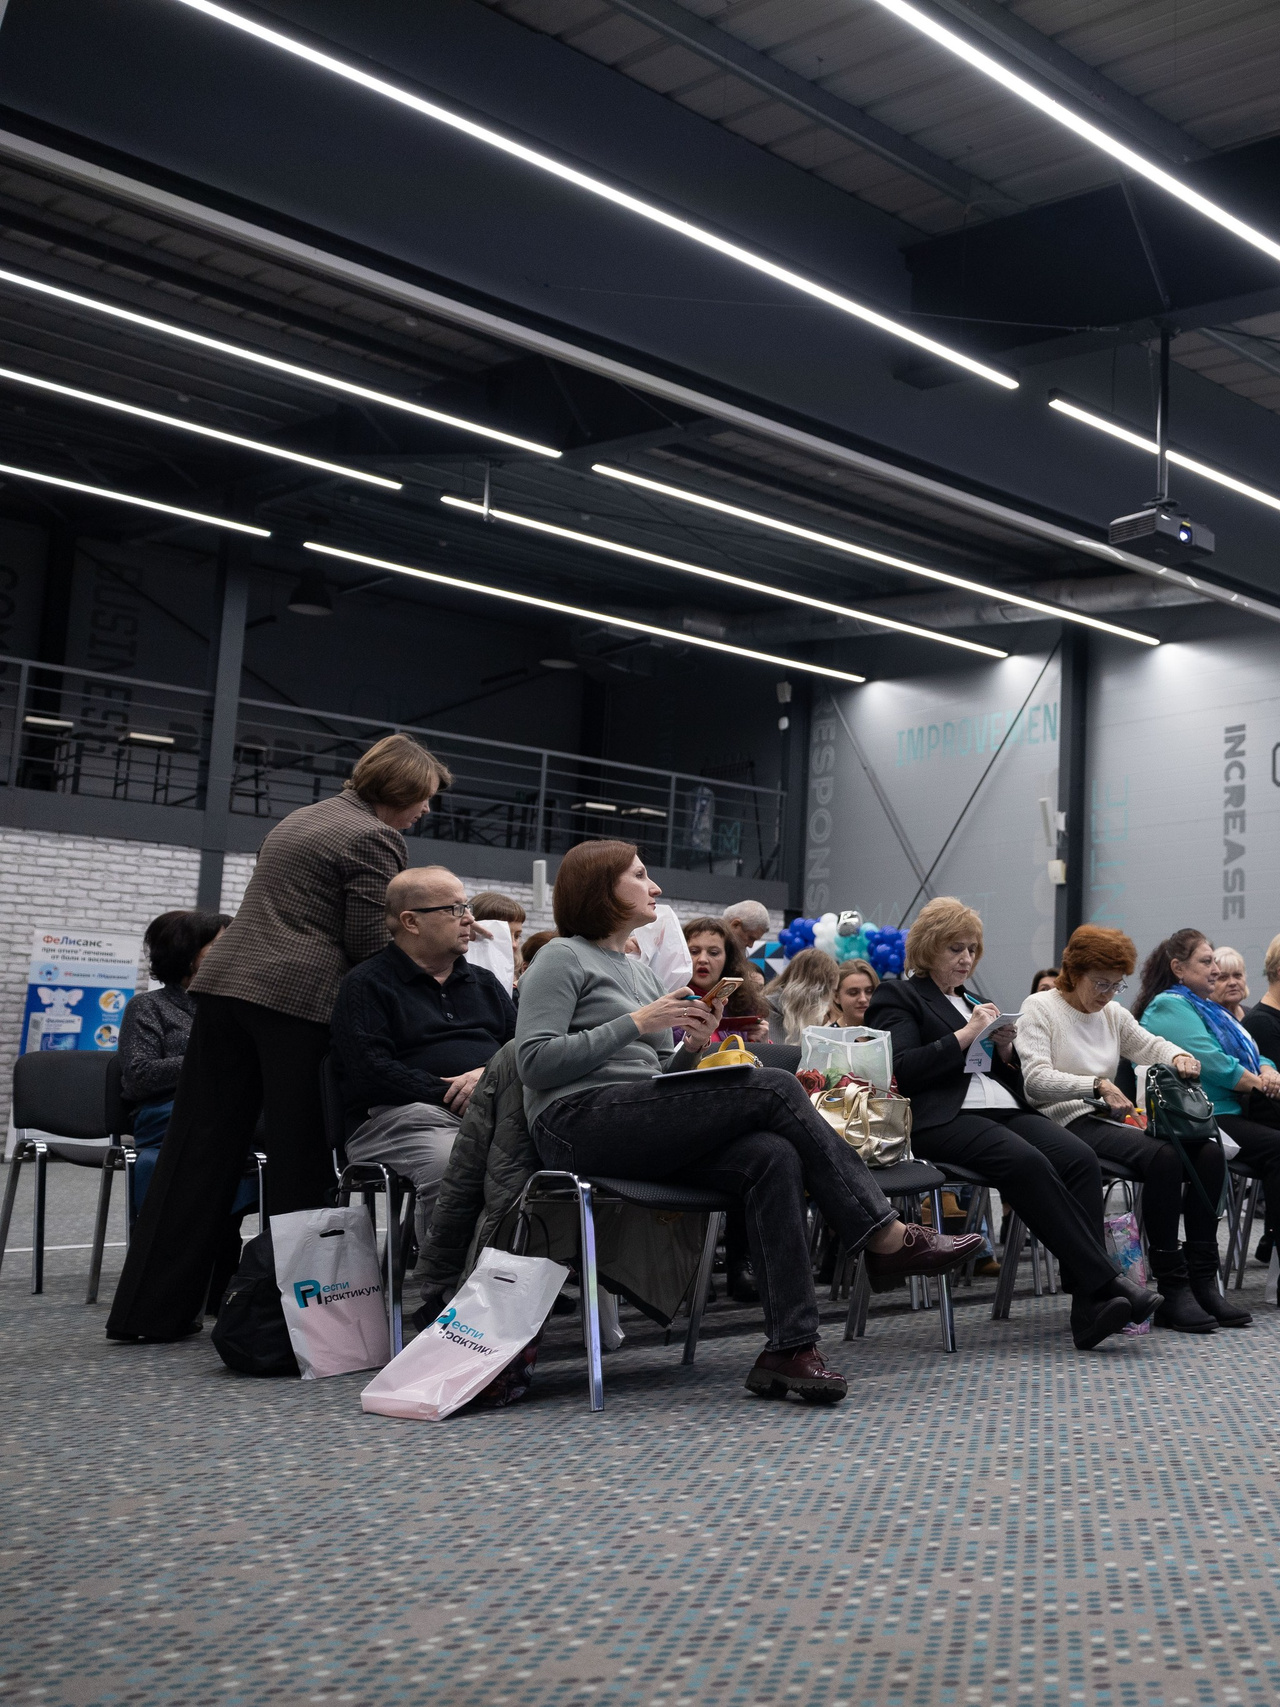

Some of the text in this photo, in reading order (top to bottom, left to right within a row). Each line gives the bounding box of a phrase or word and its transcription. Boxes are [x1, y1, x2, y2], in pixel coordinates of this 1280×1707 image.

[895, 702, 1058, 768] IMPROVEMEN
[803, 692, 837, 913] RESPONS
[1222, 723, 1247, 921] INCREASE
[42, 934, 103, 949] ФеЛисанс
